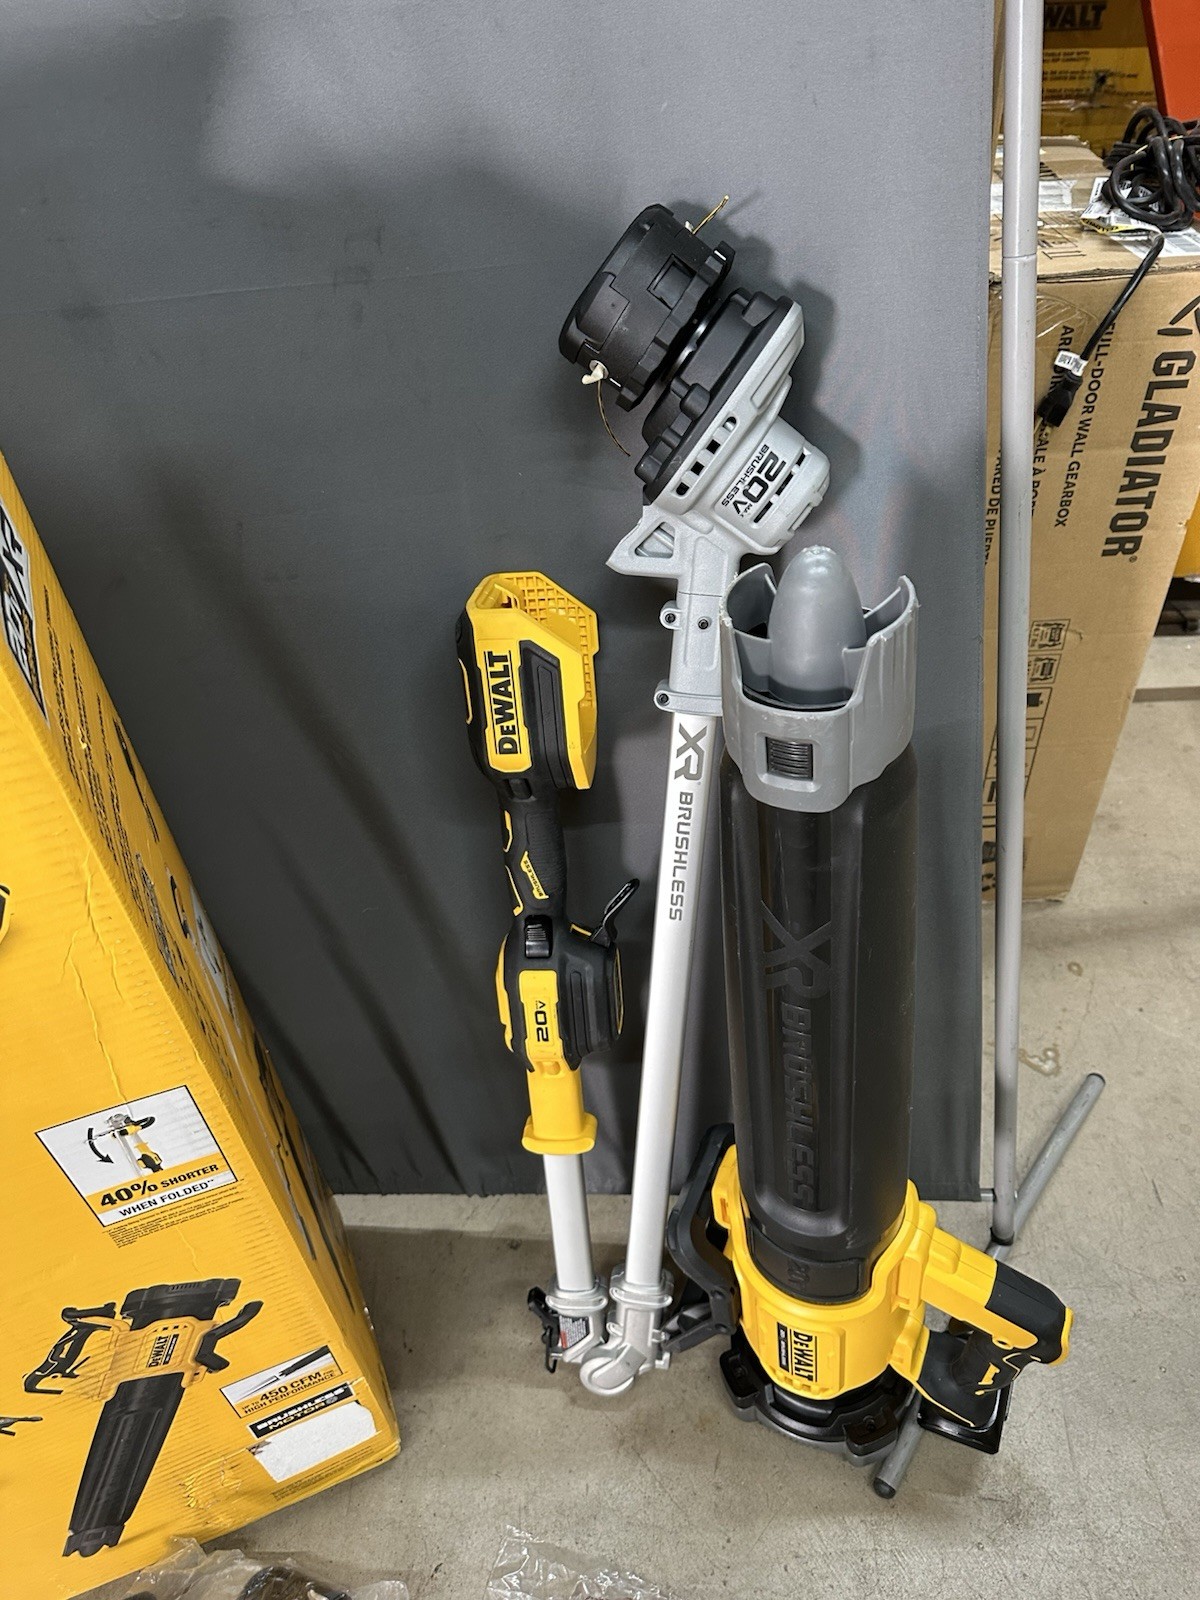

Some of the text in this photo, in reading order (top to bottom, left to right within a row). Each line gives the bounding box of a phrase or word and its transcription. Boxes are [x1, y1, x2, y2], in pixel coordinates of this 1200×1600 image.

[1044, 4, 1107, 28] WALT
[1070, 417, 1093, 457] WALL
[1101, 351, 1196, 557] GLADIATOR
[721, 444, 769, 506] BRUSHLESS
[732, 451, 787, 514] 20V
[1055, 461, 1080, 527] GEARBOX
[987, 498, 1000, 515] DE
[669, 723, 707, 921] XR BRUSHLESS
[534, 1001, 550, 1042] 20V
[761, 899, 831, 1210] XR BRUSHLESS
[100, 1164, 219, 1206] 40% SHORTER
[119, 1199, 158, 1217] WHEN
[244, 1373, 335, 1415] HIGH PERFORMANCE
[260, 1386, 288, 1402] 450
[290, 1371, 322, 1388] CFM
[256, 1388, 345, 1431] BRUSHLESS
